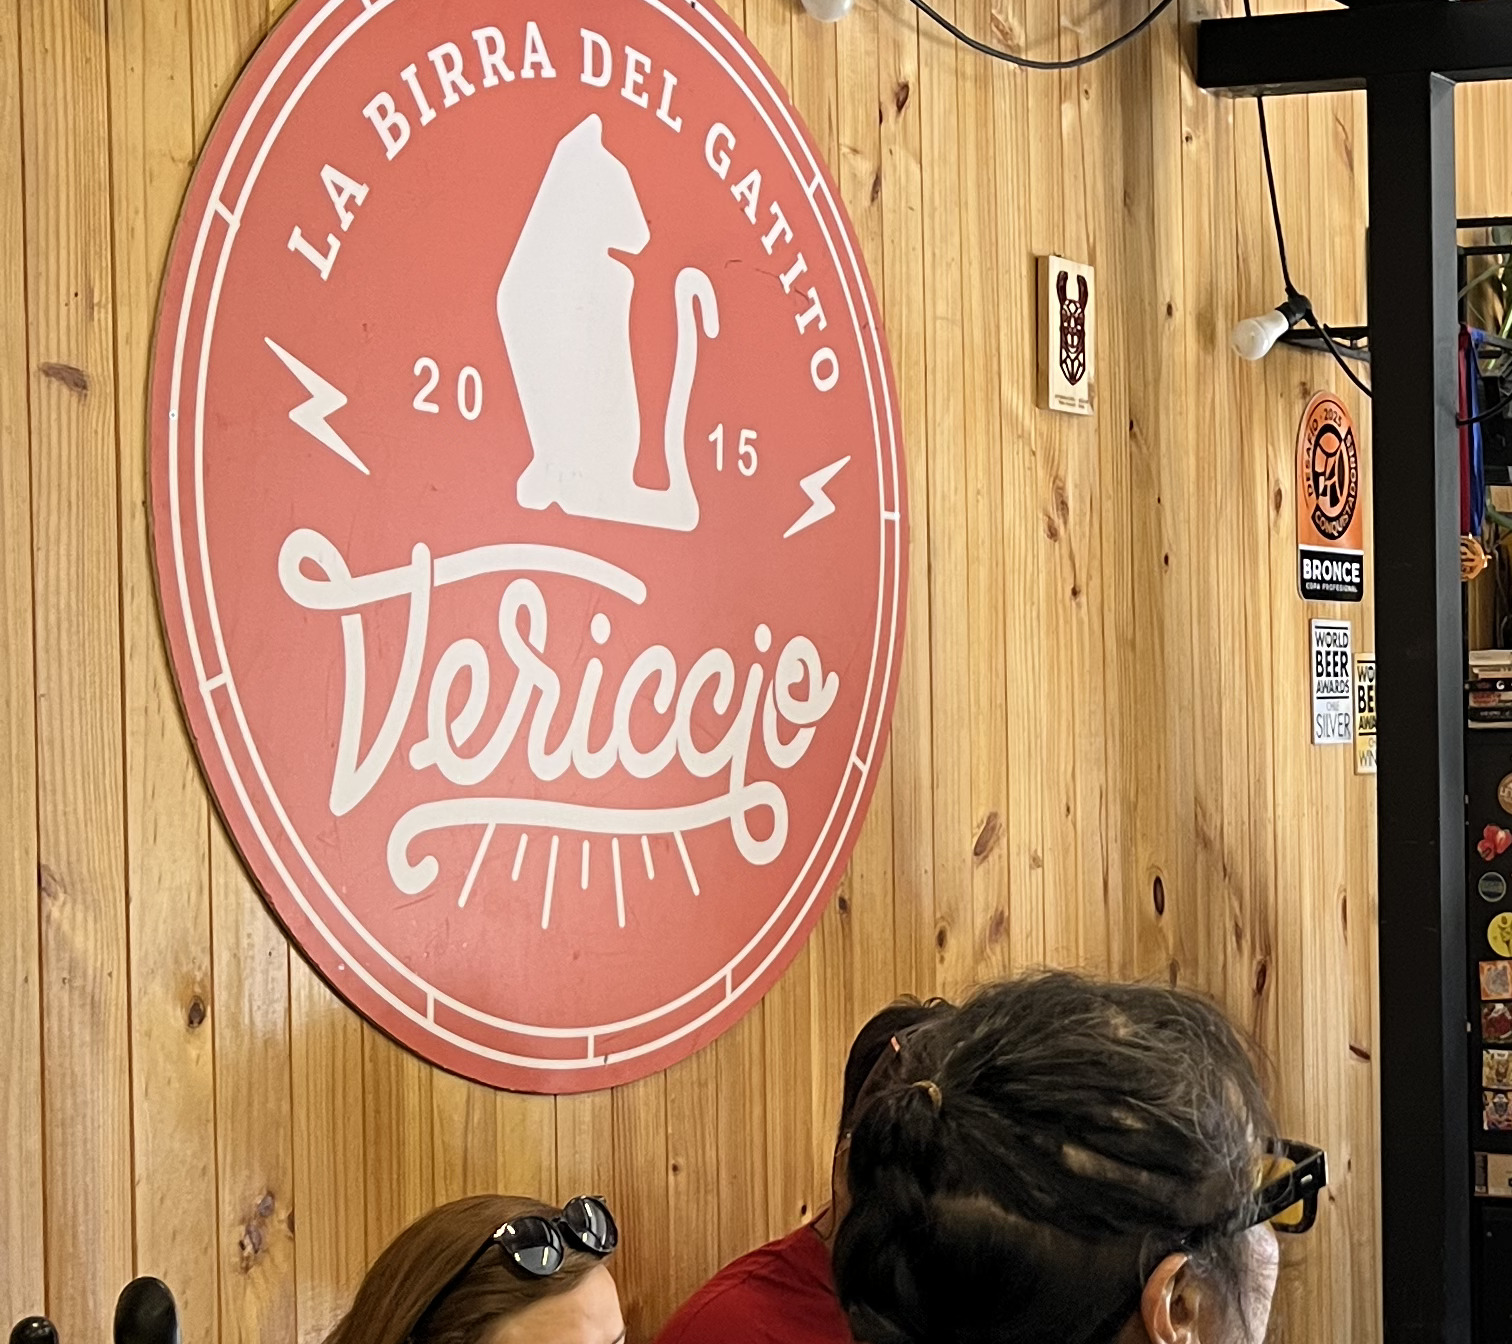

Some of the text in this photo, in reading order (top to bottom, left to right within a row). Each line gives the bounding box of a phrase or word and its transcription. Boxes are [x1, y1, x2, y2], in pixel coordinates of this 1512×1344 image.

[287, 21, 839, 393] LA BIRRA DEL GATITO
[413, 357, 757, 477] 20 15
[1303, 558, 1361, 583] BRONCE
[1305, 581, 1321, 590] COPA
[1315, 631, 1349, 648] WORLD
[1315, 650, 1349, 678] BEER
[1316, 679, 1350, 694] AWARDS
[1316, 712, 1351, 739] SILVER
